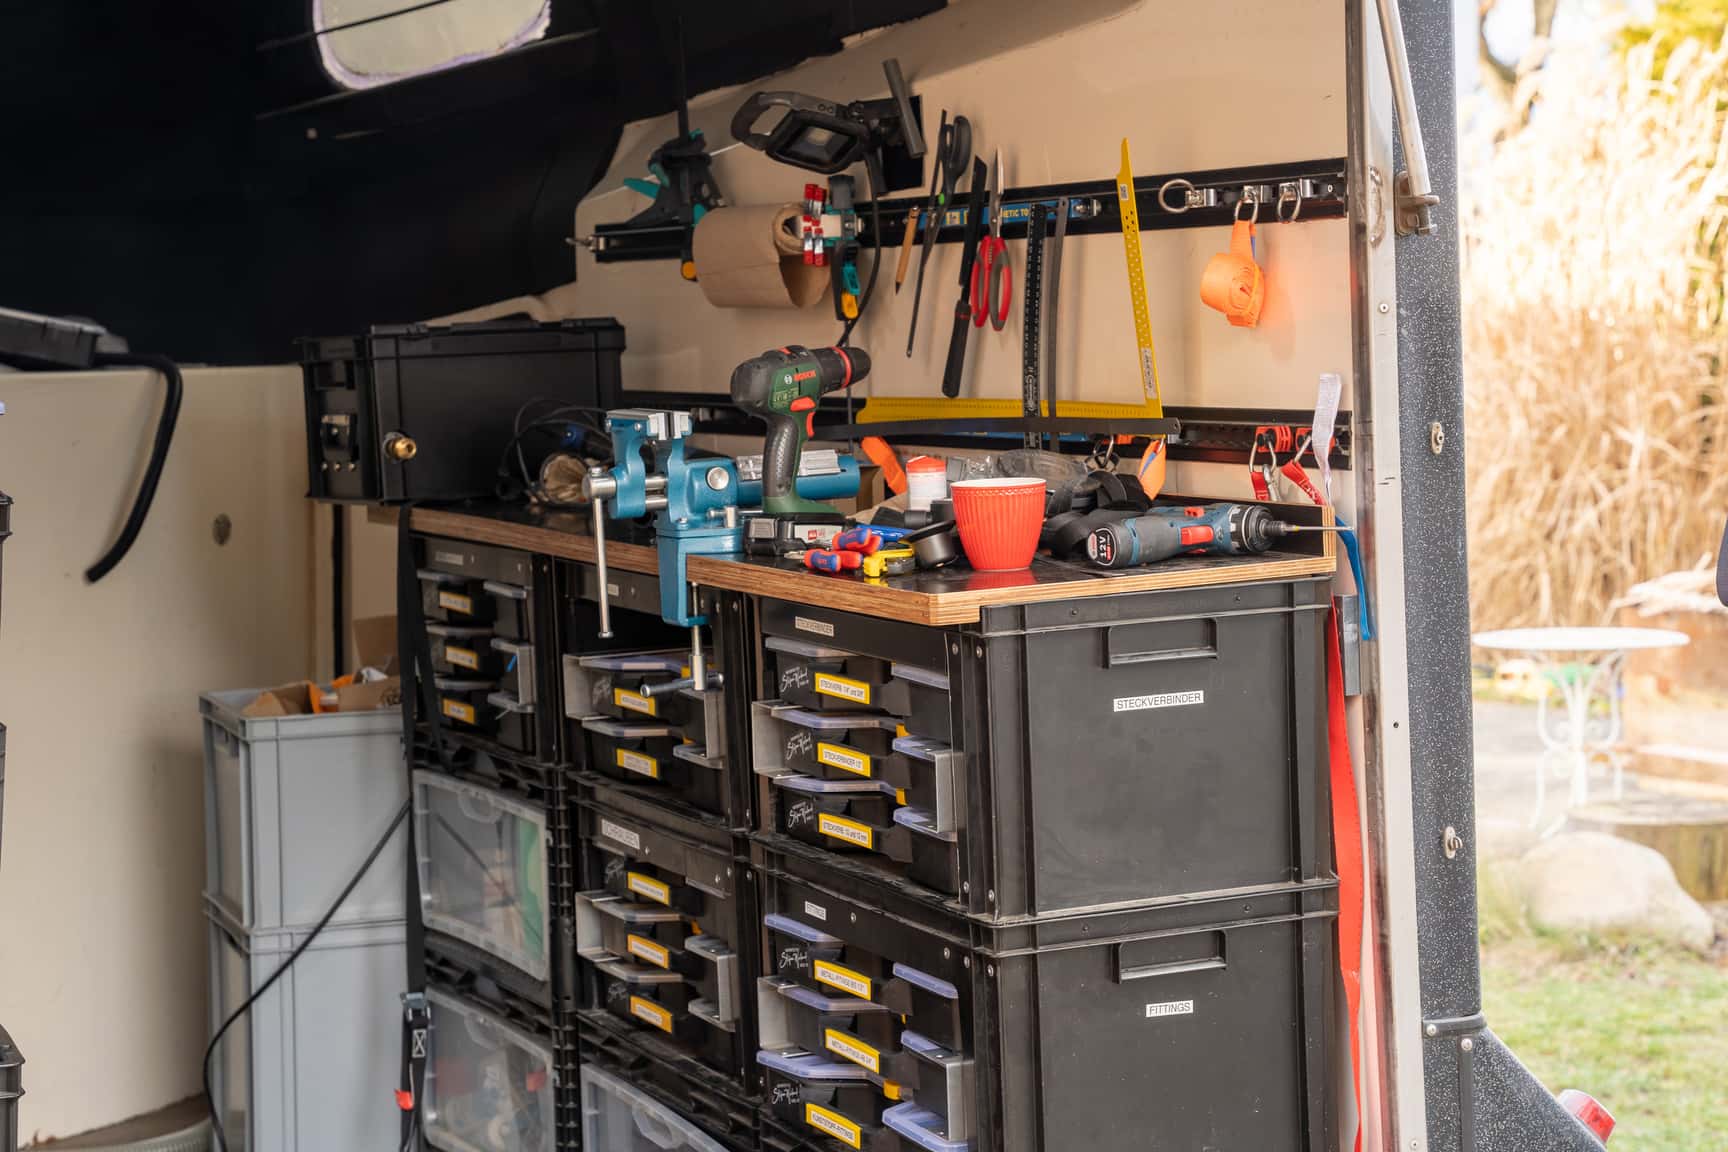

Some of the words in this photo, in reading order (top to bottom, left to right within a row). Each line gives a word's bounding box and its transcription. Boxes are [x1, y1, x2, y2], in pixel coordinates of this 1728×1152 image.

[1099, 536, 1107, 558] 12V
[1117, 692, 1201, 709] STECKVERBINDER
[1150, 1002, 1190, 1014] FITTINGS
